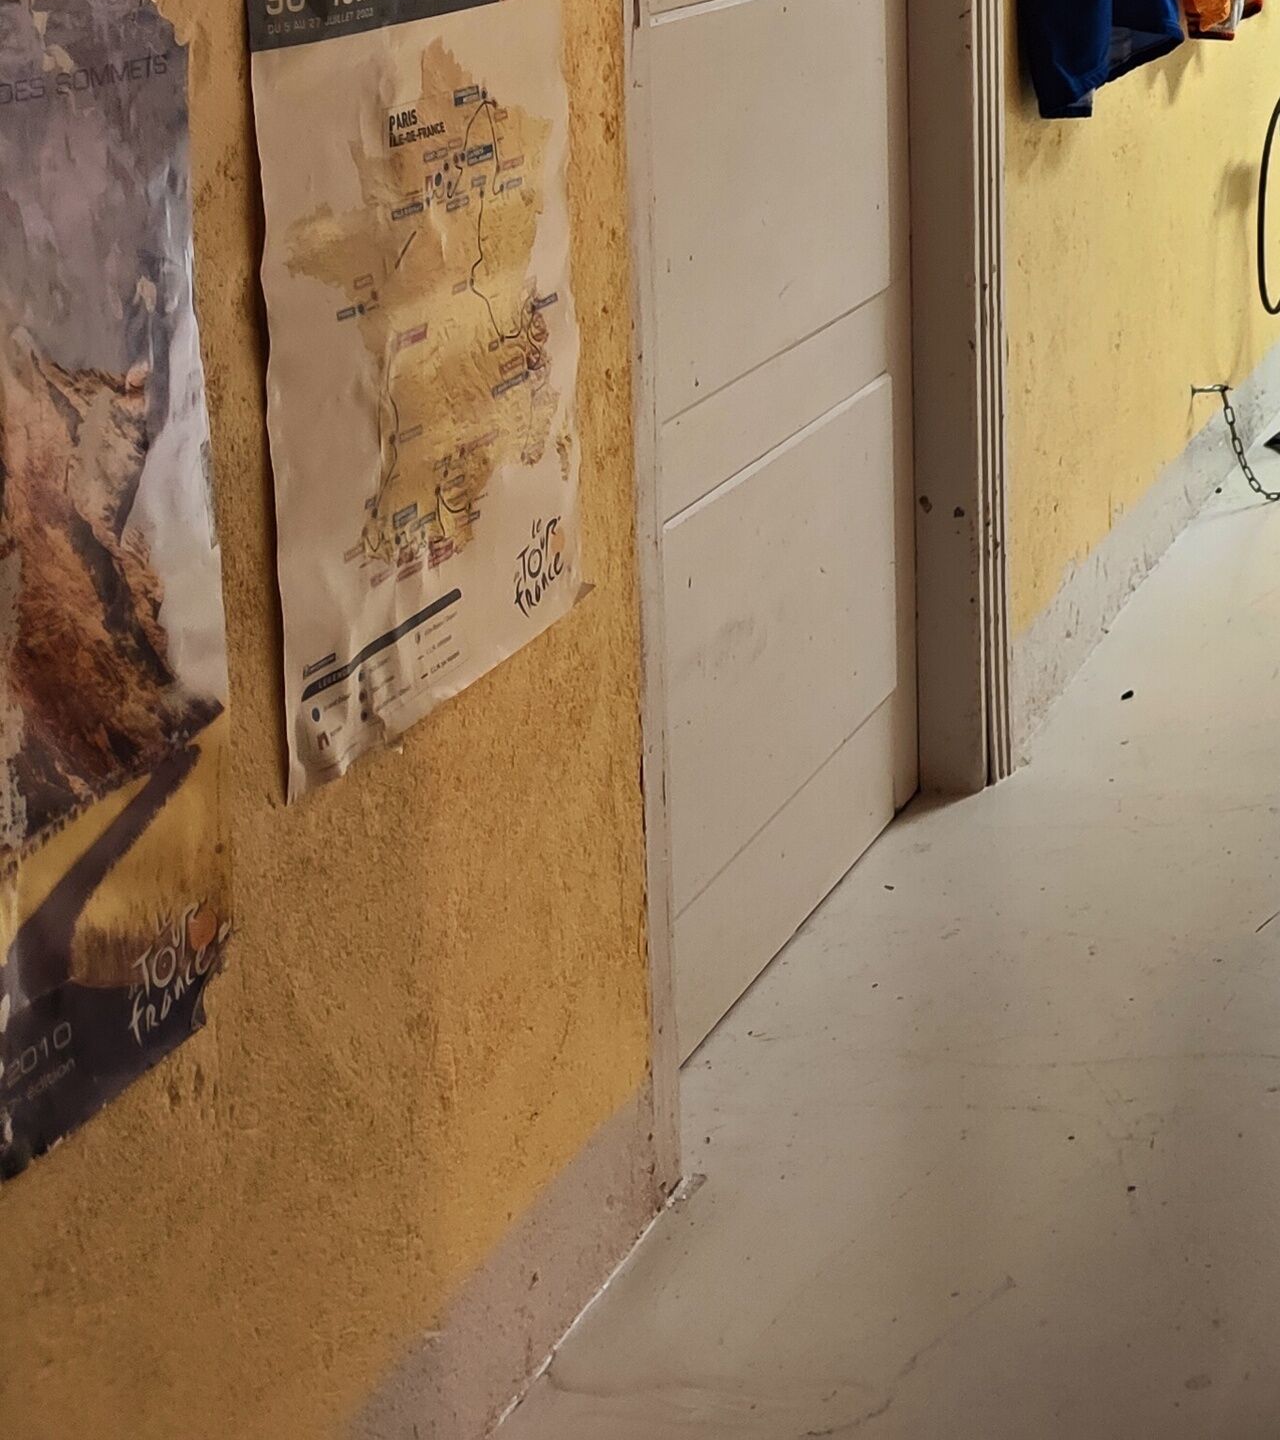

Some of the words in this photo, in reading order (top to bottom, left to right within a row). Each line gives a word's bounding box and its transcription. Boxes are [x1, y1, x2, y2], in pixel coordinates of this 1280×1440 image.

[56, 54, 169, 94] SOMMETS
[388, 109, 419, 133] PARIS
[7, 1020, 73, 1090] 2010
